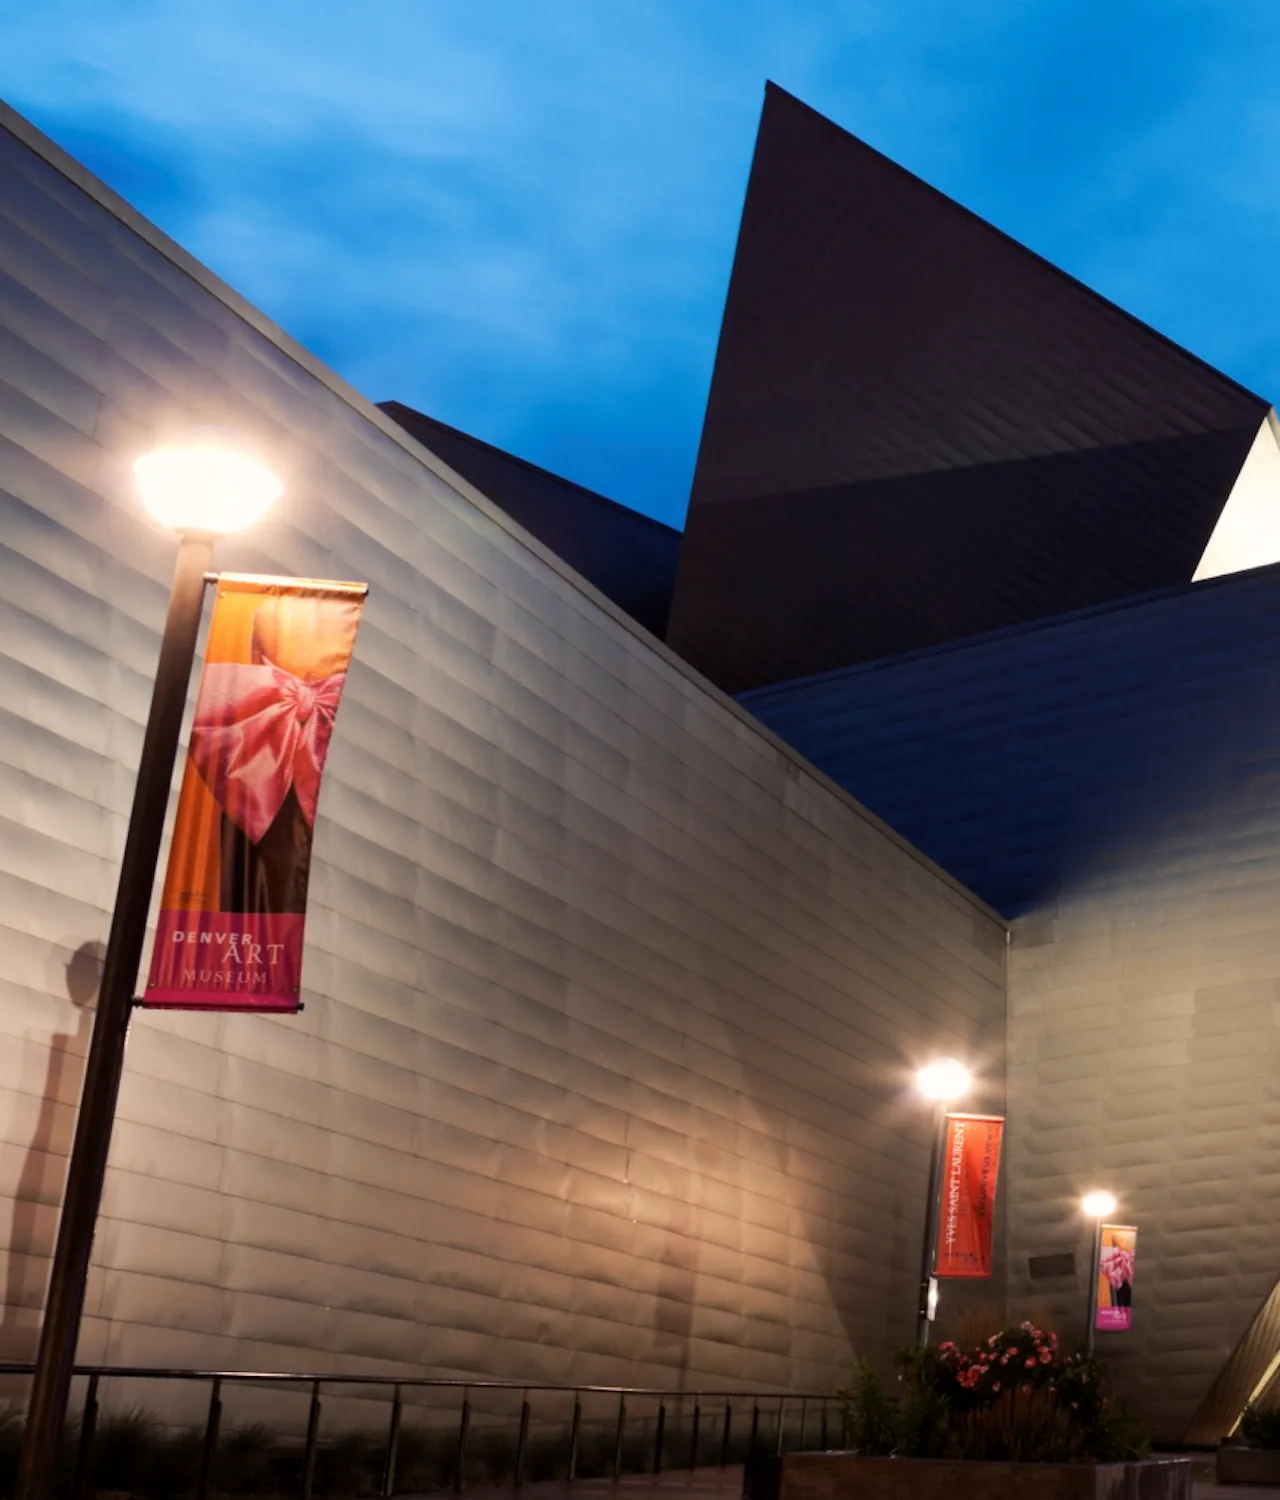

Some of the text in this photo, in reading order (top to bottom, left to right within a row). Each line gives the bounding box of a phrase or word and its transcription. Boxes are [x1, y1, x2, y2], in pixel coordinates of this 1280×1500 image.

[172, 930, 252, 945] DENVER
[221, 942, 285, 965] ART
[183, 969, 267, 984] MUSEUM
[951, 1121, 965, 1176] LAURENT
[947, 1177, 960, 1214] SAINT
